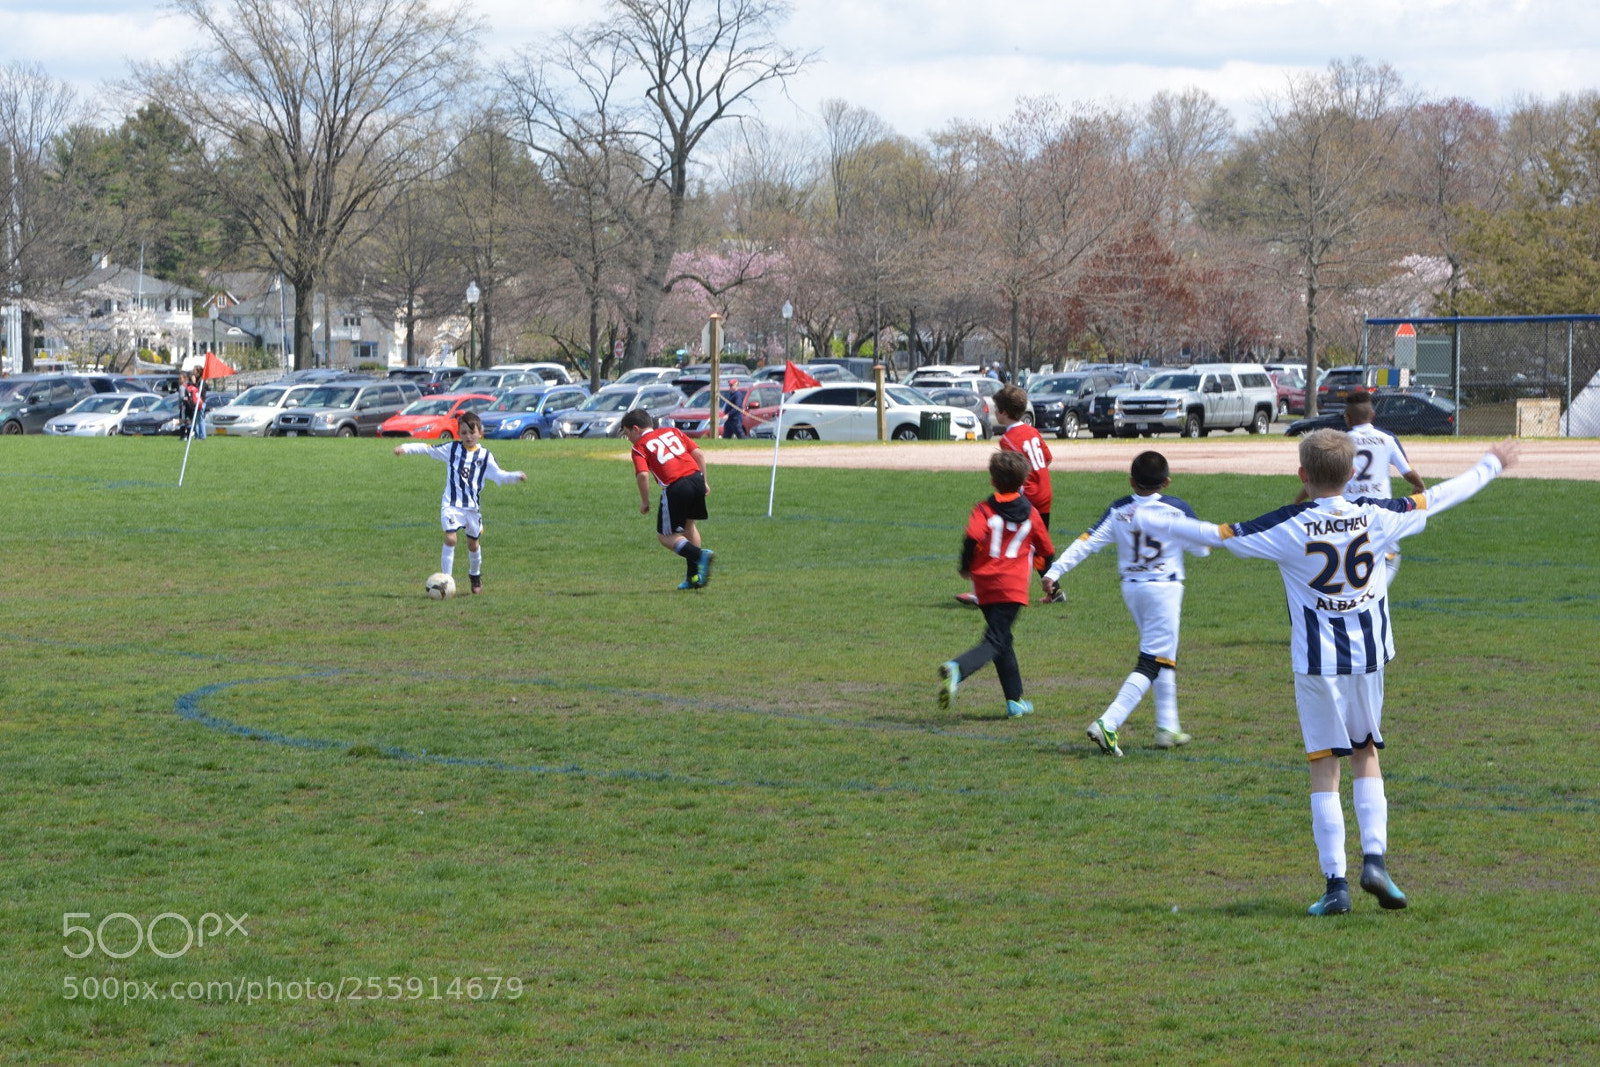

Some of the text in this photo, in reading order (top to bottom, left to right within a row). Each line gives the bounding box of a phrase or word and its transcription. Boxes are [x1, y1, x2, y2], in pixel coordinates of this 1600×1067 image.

[646, 431, 686, 464] 25
[1022, 437, 1046, 471] 16
[461, 467, 470, 479] 8
[1355, 449, 1373, 482] 2
[987, 514, 1032, 559] 17
[1130, 530, 1162, 564] 15
[1305, 531, 1376, 596] 26
